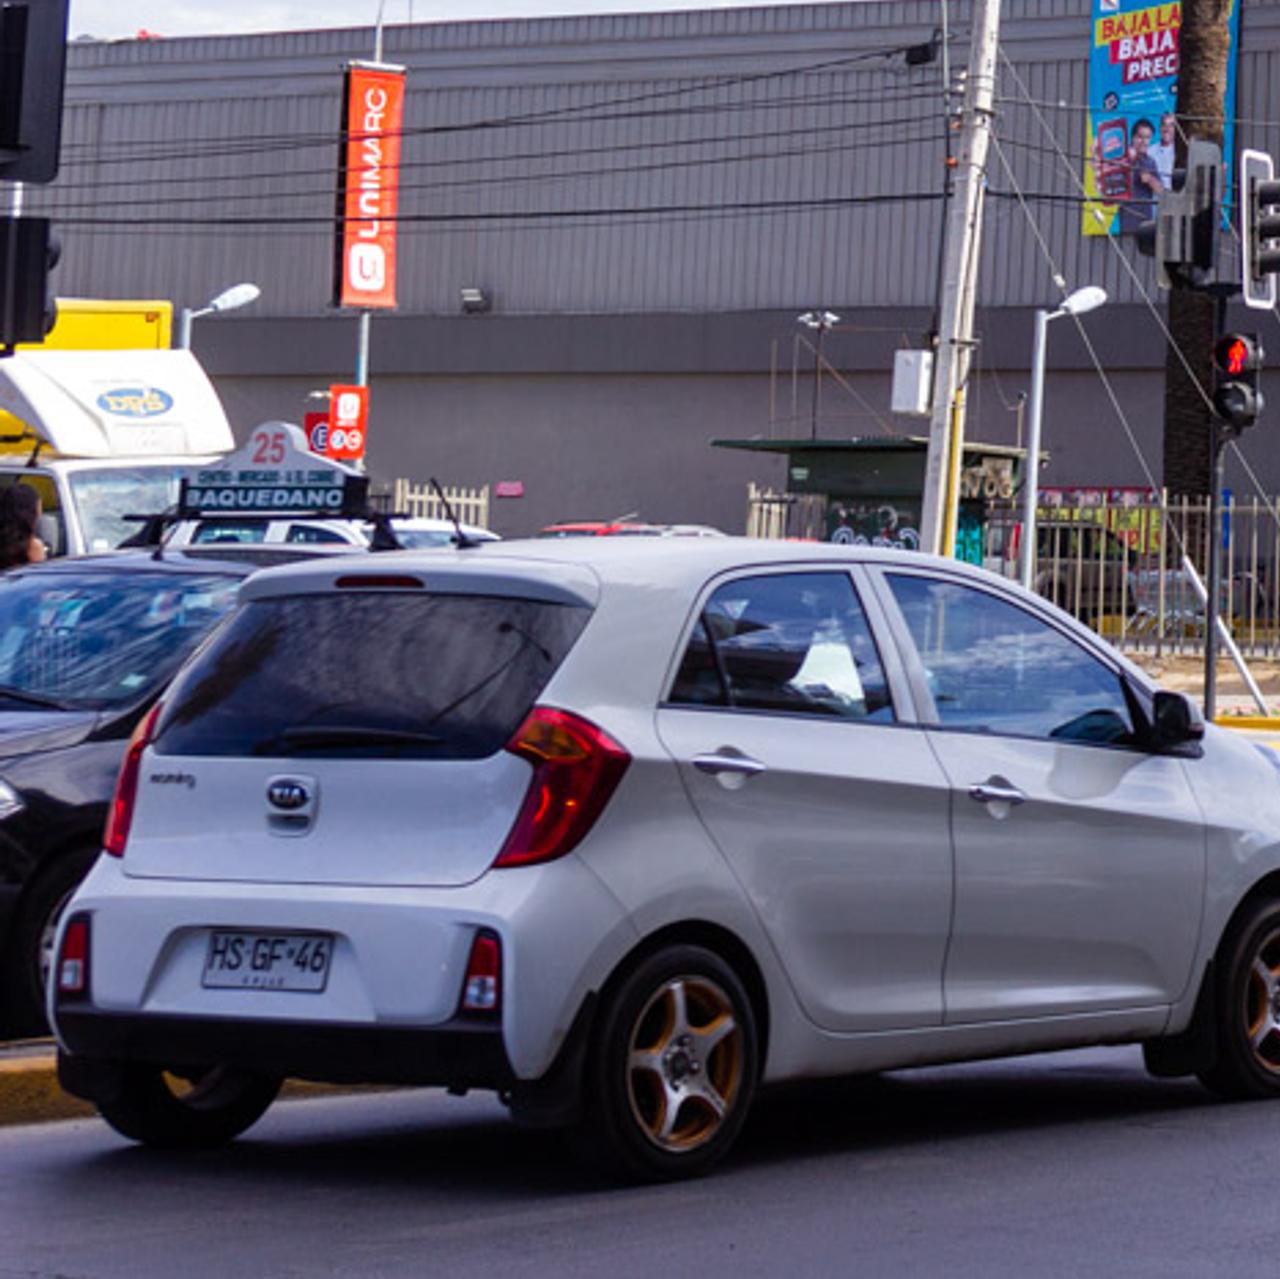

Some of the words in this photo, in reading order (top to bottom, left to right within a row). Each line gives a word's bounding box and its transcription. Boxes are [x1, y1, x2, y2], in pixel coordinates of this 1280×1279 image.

[1101, 9, 1152, 40] BAJA
[1118, 28, 1175, 60] BAJA
[1127, 53, 1177, 81] PREC
[358, 88, 387, 240] UNIMARC
[253, 432, 286, 464] 25
[186, 488, 343, 507] BAQUEDANO
